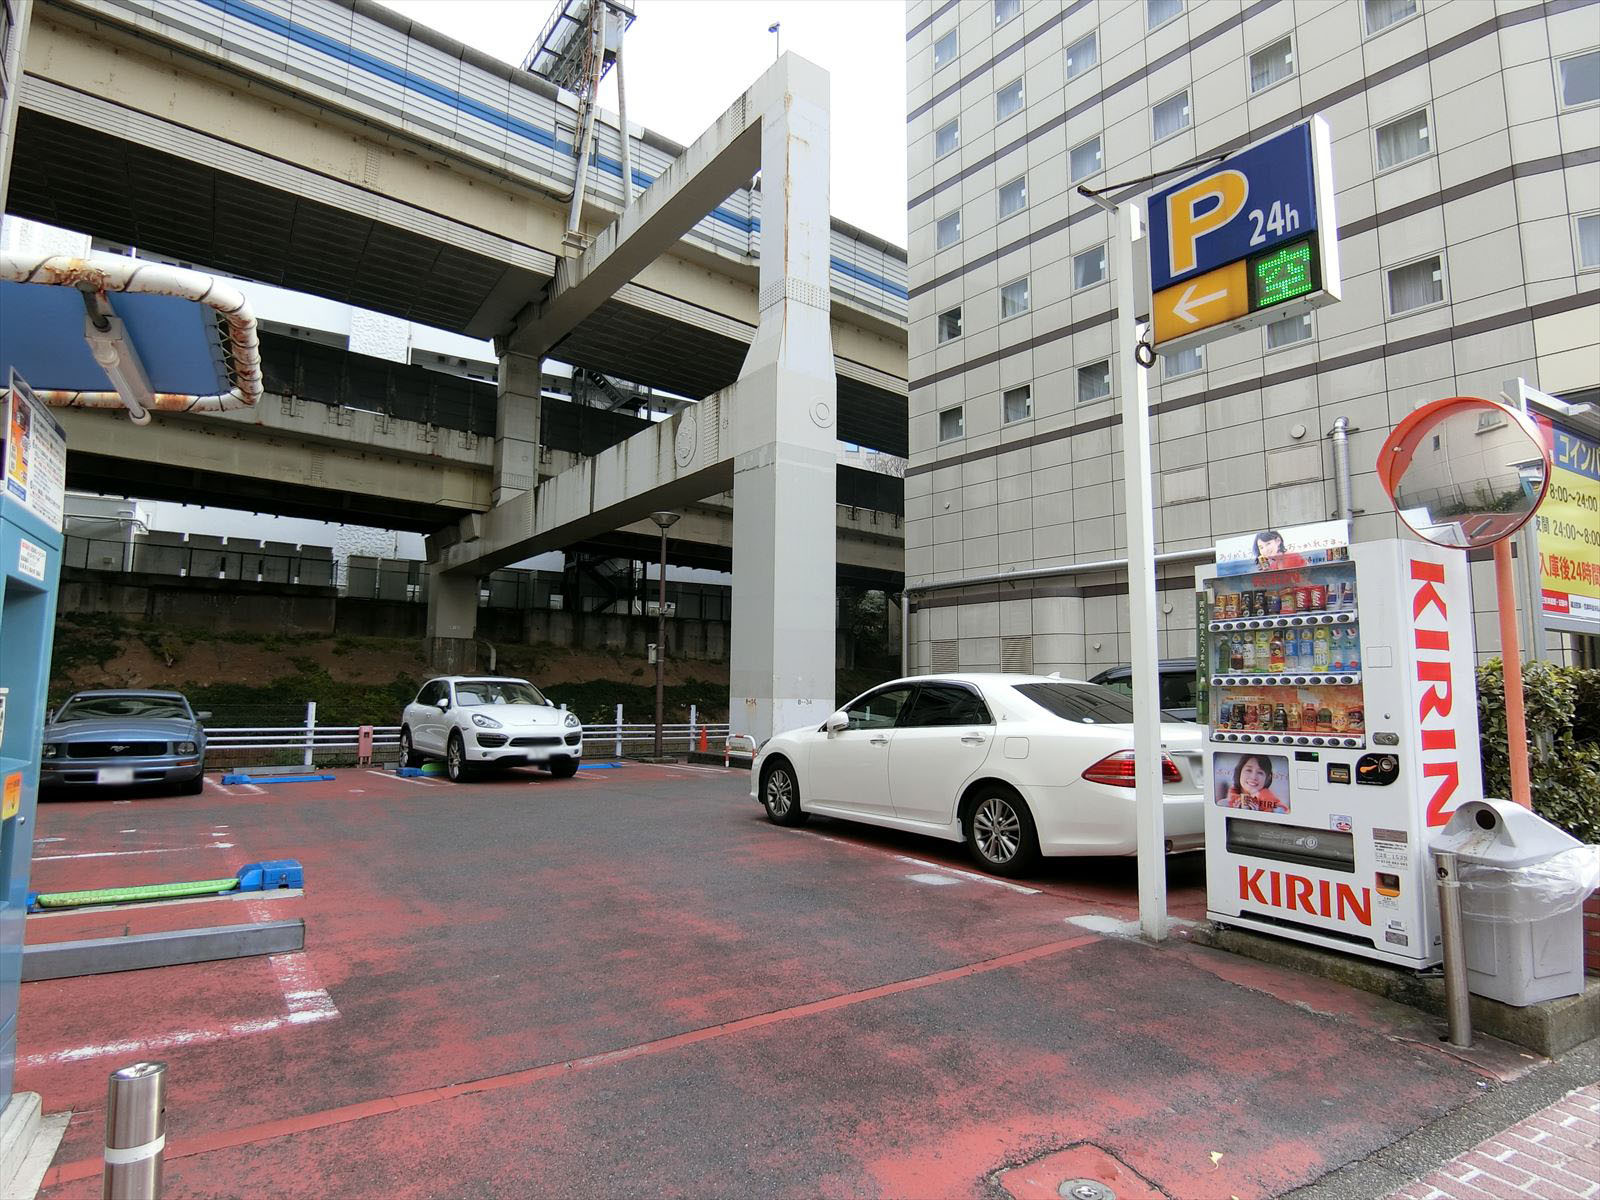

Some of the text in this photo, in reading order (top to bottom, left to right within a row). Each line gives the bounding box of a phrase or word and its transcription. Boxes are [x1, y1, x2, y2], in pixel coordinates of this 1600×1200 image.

[1165, 169, 1249, 279] P
[1248, 200, 1300, 247] 24h
[1256, 247, 1313, 308] 空
[1410, 559, 1459, 828] KIRIN
[1238, 865, 1372, 927] KIRIN
